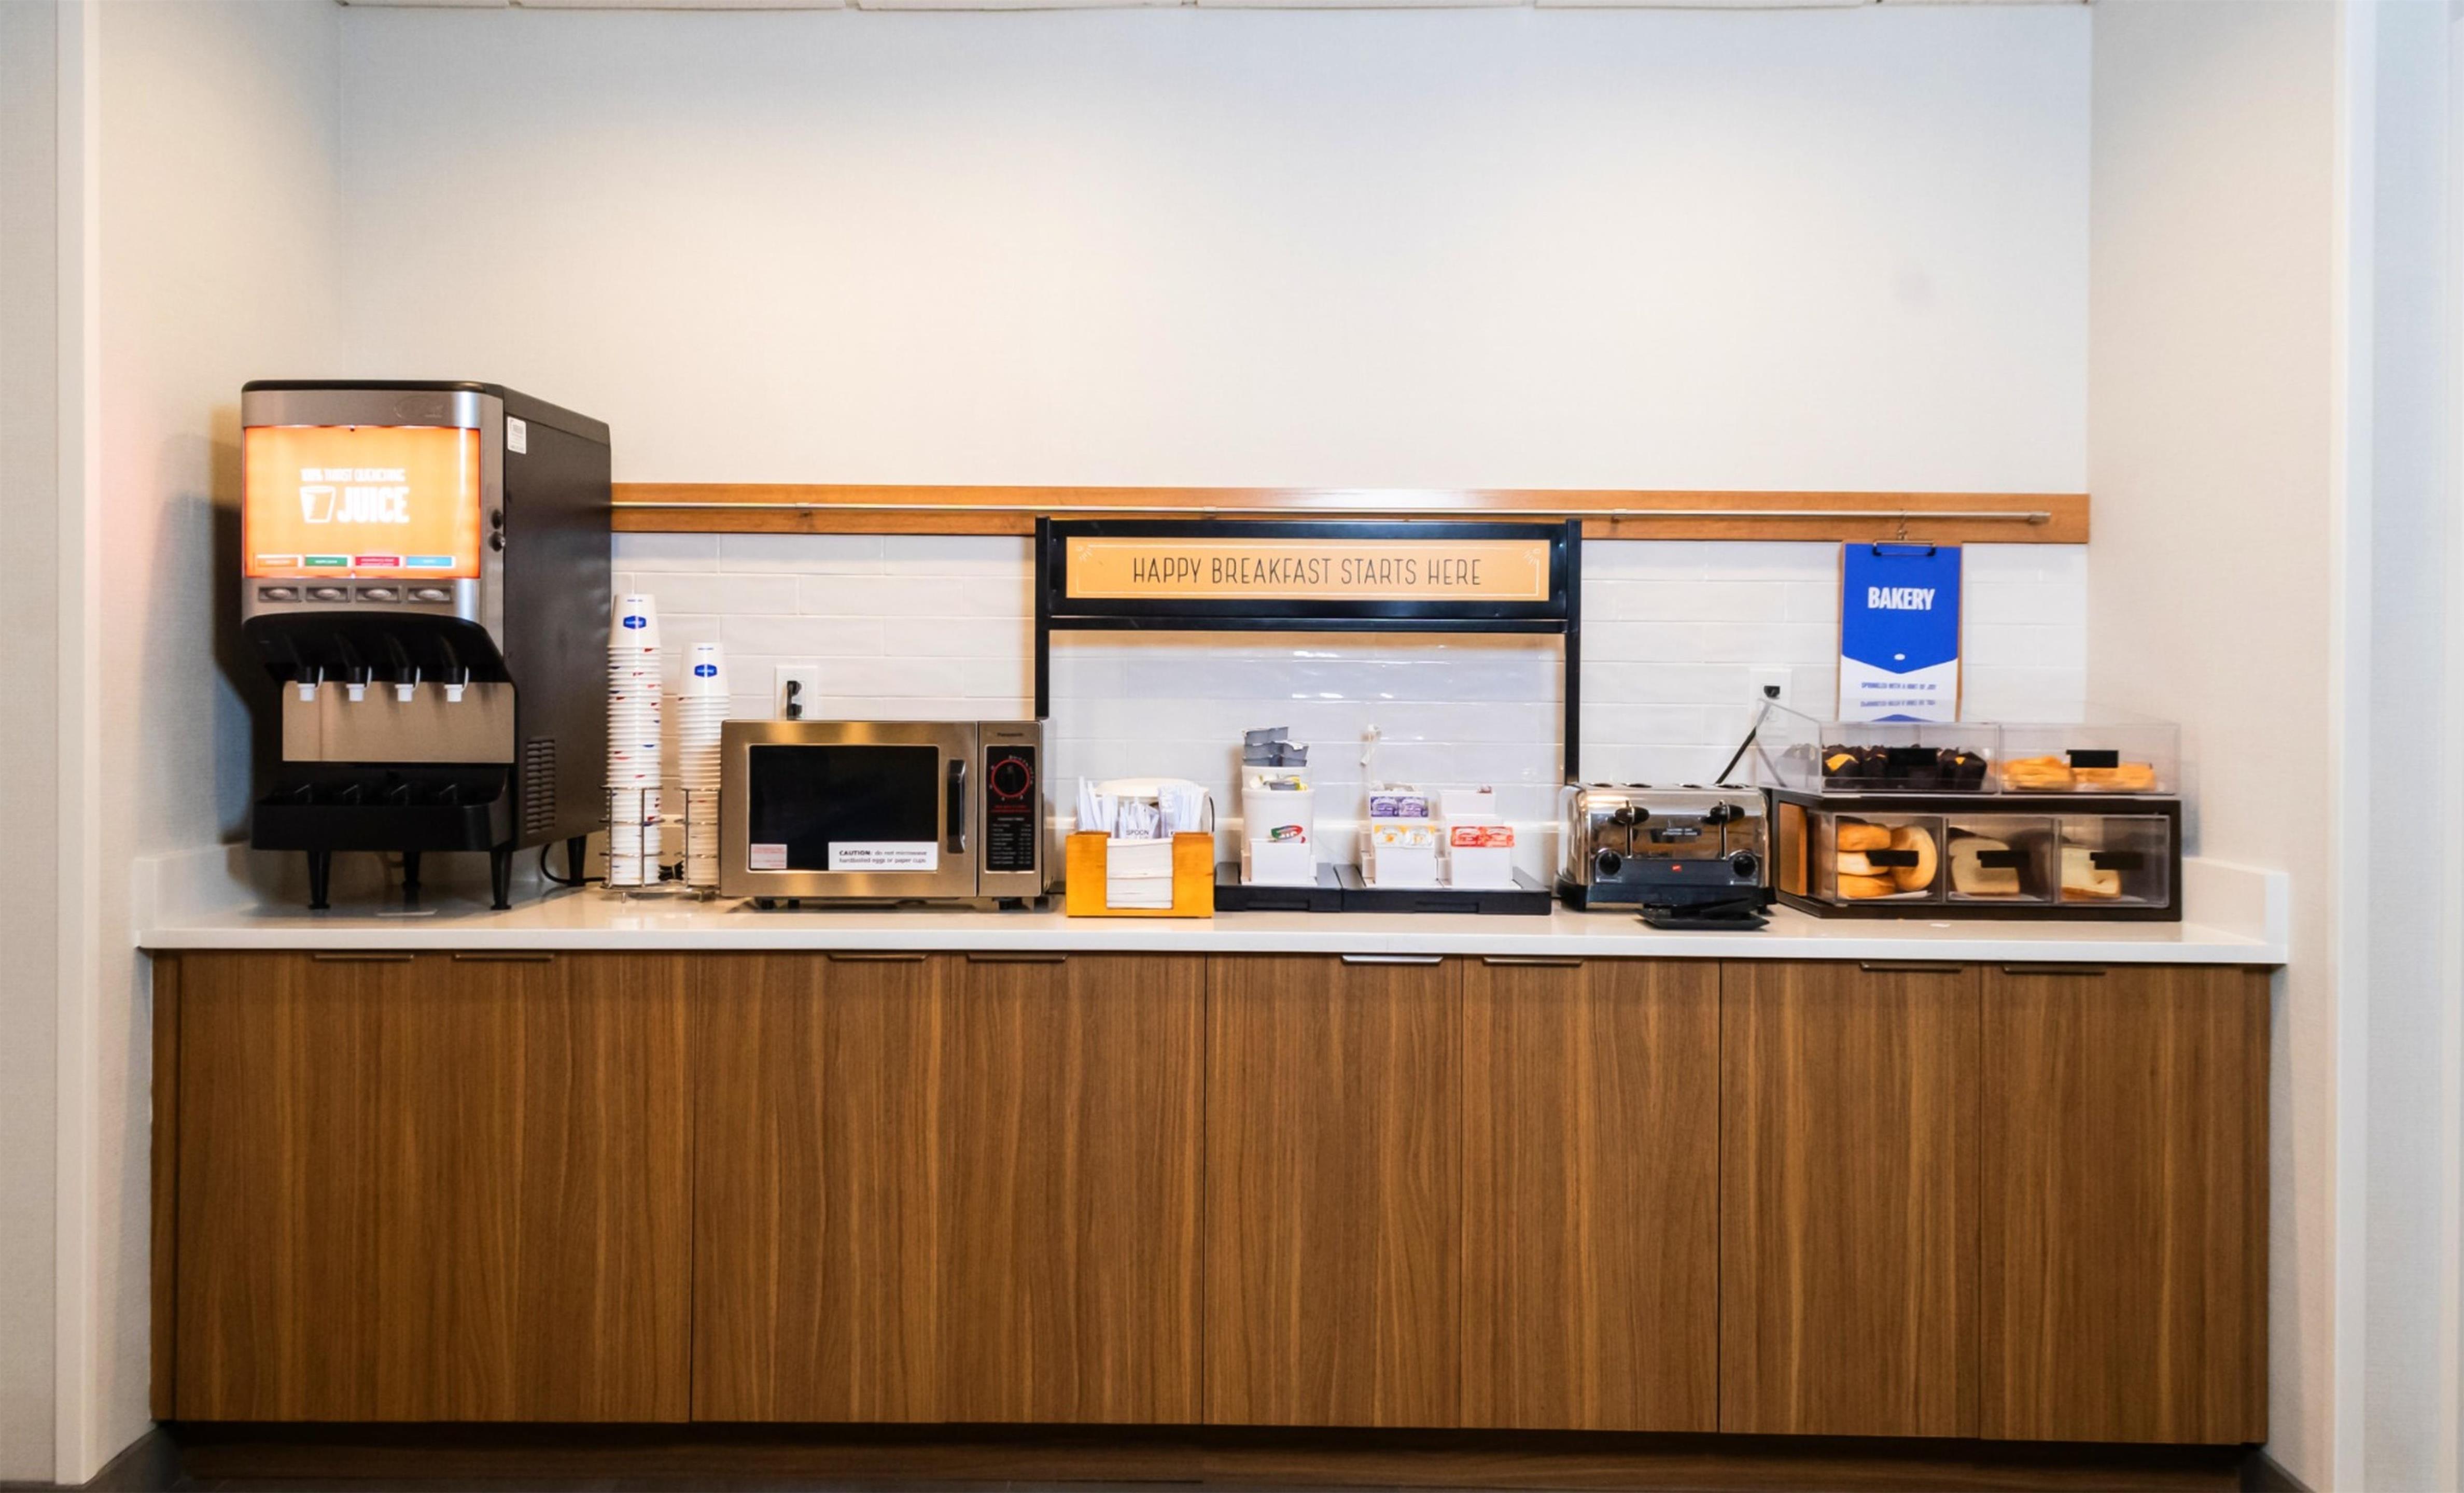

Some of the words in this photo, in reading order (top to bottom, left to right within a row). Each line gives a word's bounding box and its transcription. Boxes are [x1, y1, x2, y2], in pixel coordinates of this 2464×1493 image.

[337, 486, 410, 524] JUICE
[1133, 558, 1202, 584] HAPPY
[1212, 558, 1332, 585] BREAKFAST
[1341, 558, 1417, 585] STARTS
[1428, 559, 1481, 585] HERE
[1868, 586, 1936, 611] BAKERY
